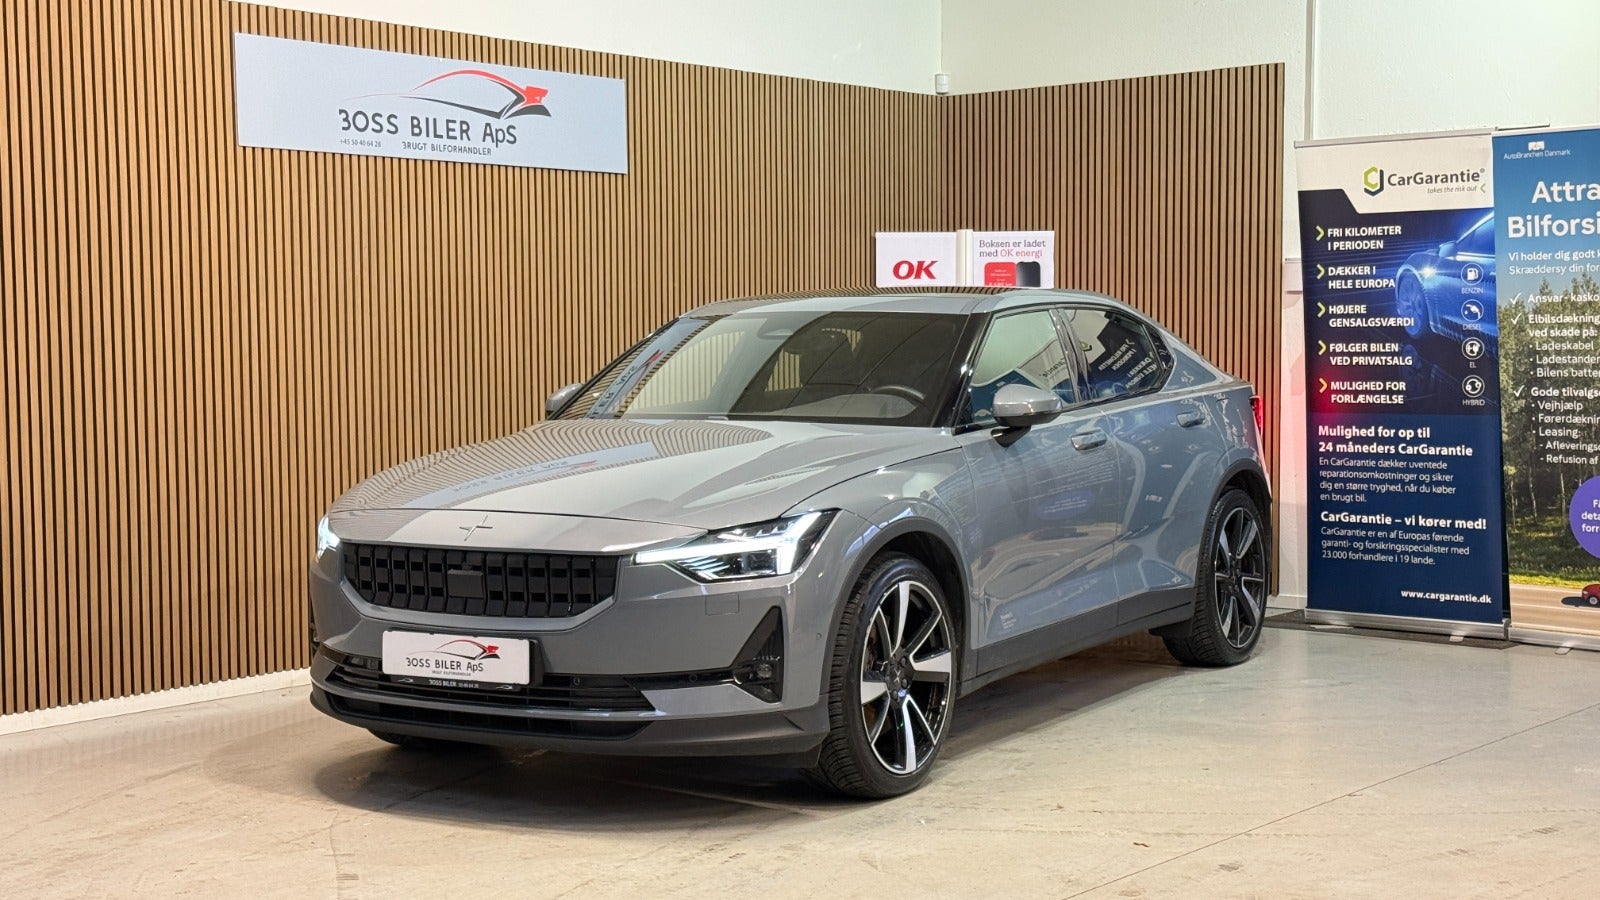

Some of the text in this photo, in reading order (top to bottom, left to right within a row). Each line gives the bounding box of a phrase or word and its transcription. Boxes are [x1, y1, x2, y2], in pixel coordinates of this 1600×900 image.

[410, 115, 471, 141] BILER
[482, 122, 517, 148] ApS
[431, 144, 492, 156] BILFORHANDLER
[1503, 149, 1571, 160] AutoBranchen Danmark
[1427, 186, 1442, 194] takes
[1443, 185, 1453, 193] the
[1454, 185, 1465, 193] risk
[1328, 225, 1402, 238] FRI KILOMETER
[979, 240, 1010, 248] Boksen
[1024, 240, 1046, 248] ladet
[1328, 239, 1384, 251] I PERIODEN
[979, 249, 1043, 258] med OK energi
[1508, 251, 1518, 261] Vi
[1520, 250, 1552, 261] holder
[1554, 250, 1570, 261] dig
[1572, 249, 1595, 260] godt
[892, 260, 938, 280] OK
[1328, 266, 1376, 276] DÆKKER I
[1509, 265, 1566, 275] Skræddersy
[1569, 263, 1584, 273] din
[1328, 279, 1395, 289] HELE EUROPA
[1329, 305, 1367, 315] HØJERE
[1329, 317, 1415, 328] GENSALGSVÆRDI
[1528, 327, 1598, 339] ved skade på:
[1329, 343, 1399, 353] FØLGER BILEN
[1535, 340, 1594, 351] Ladeskabel
[1330, 356, 1413, 366] VED PRIVATSALG
[1536, 367, 1569, 377] Bilens
[1330, 381, 1406, 391] MULIGHED FOR
[1531, 387, 1559, 397] Gode
[1331, 394, 1404, 404] FORLÆNGELSE
[1537, 400, 1583, 412] Vejhjælp
[1318, 425, 1430, 440] Mulighed for op til
[1539, 427, 1581, 439] Leasing:
[1318, 441, 1473, 457] 24 måneders CarGarantie
[1330, 458, 1376, 468] CarGarantie
[1378, 458, 1407, 468] dækker
[1408, 460, 1448, 470] uventede
[1546, 454, 1598, 464] Refusion af
[1319, 470, 1453, 482] reparationsomkostninger og sikrer
[1320, 482, 1332, 491] dig
[1345, 482, 1368, 491] større
[1370, 483, 1403, 494] tryghed,
[1404, 484, 1417, 493] når
[1419, 485, 1430, 494] du
[1432, 485, 1457, 494] køber
[1331, 493, 1354, 503] brugt
[1355, 493, 1367, 502] bil.
[1321, 511, 1392, 525] CarGarantie
[1405, 515, 1416, 526] vi
[1418, 515, 1451, 528] kører
[1455, 518, 1487, 530] med!
[1321, 527, 1367, 537] CarGarantie
[1367, 530, 1376, 538] er
[1389, 530, 1398, 539] af
[1398, 531, 1430, 541] Europas
[1432, 532, 1464, 542] førende
[1321, 539, 1470, 555] garanti- og forsikringsspecialister med
[1322, 550, 1348, 559] 23.000
[1348, 551, 1393, 562] forhandlere
[1399, 555, 1409, 564] 19
[1411, 555, 1436, 565] lande.
[1400, 590, 1492, 604] www.cargarantie.dk
[435, 659, 461, 670] BILER
[466, 662, 484, 673] ApS
